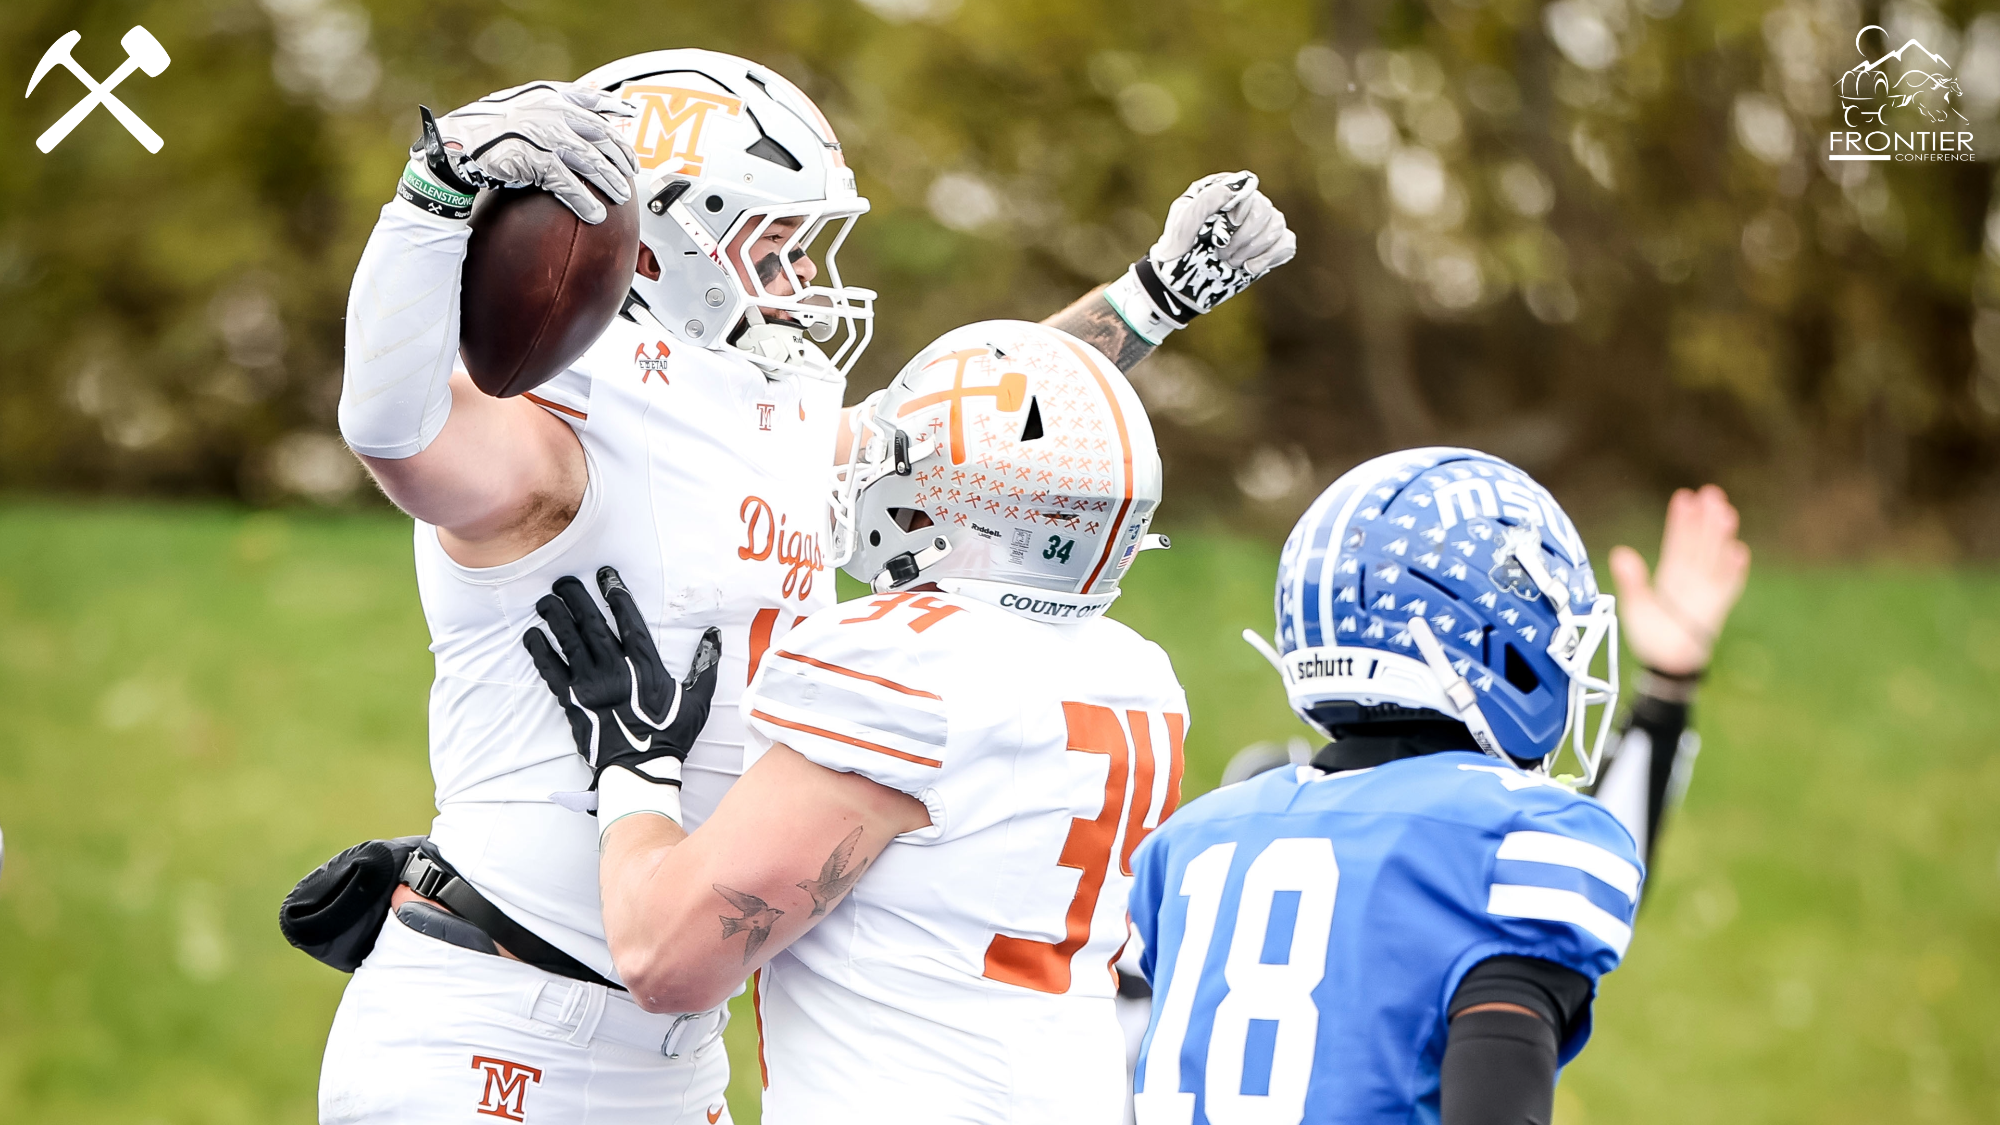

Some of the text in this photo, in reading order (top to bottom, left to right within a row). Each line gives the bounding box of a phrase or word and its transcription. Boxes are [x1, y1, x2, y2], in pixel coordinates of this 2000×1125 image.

[1042, 534, 1076, 565] 34
[1433, 477, 1590, 569] MSU
[999, 593, 1078, 618] COUNT
[1297, 654, 1354, 681] schutt
[981, 700, 1184, 1000] 34
[1133, 837, 1341, 1125] 18
